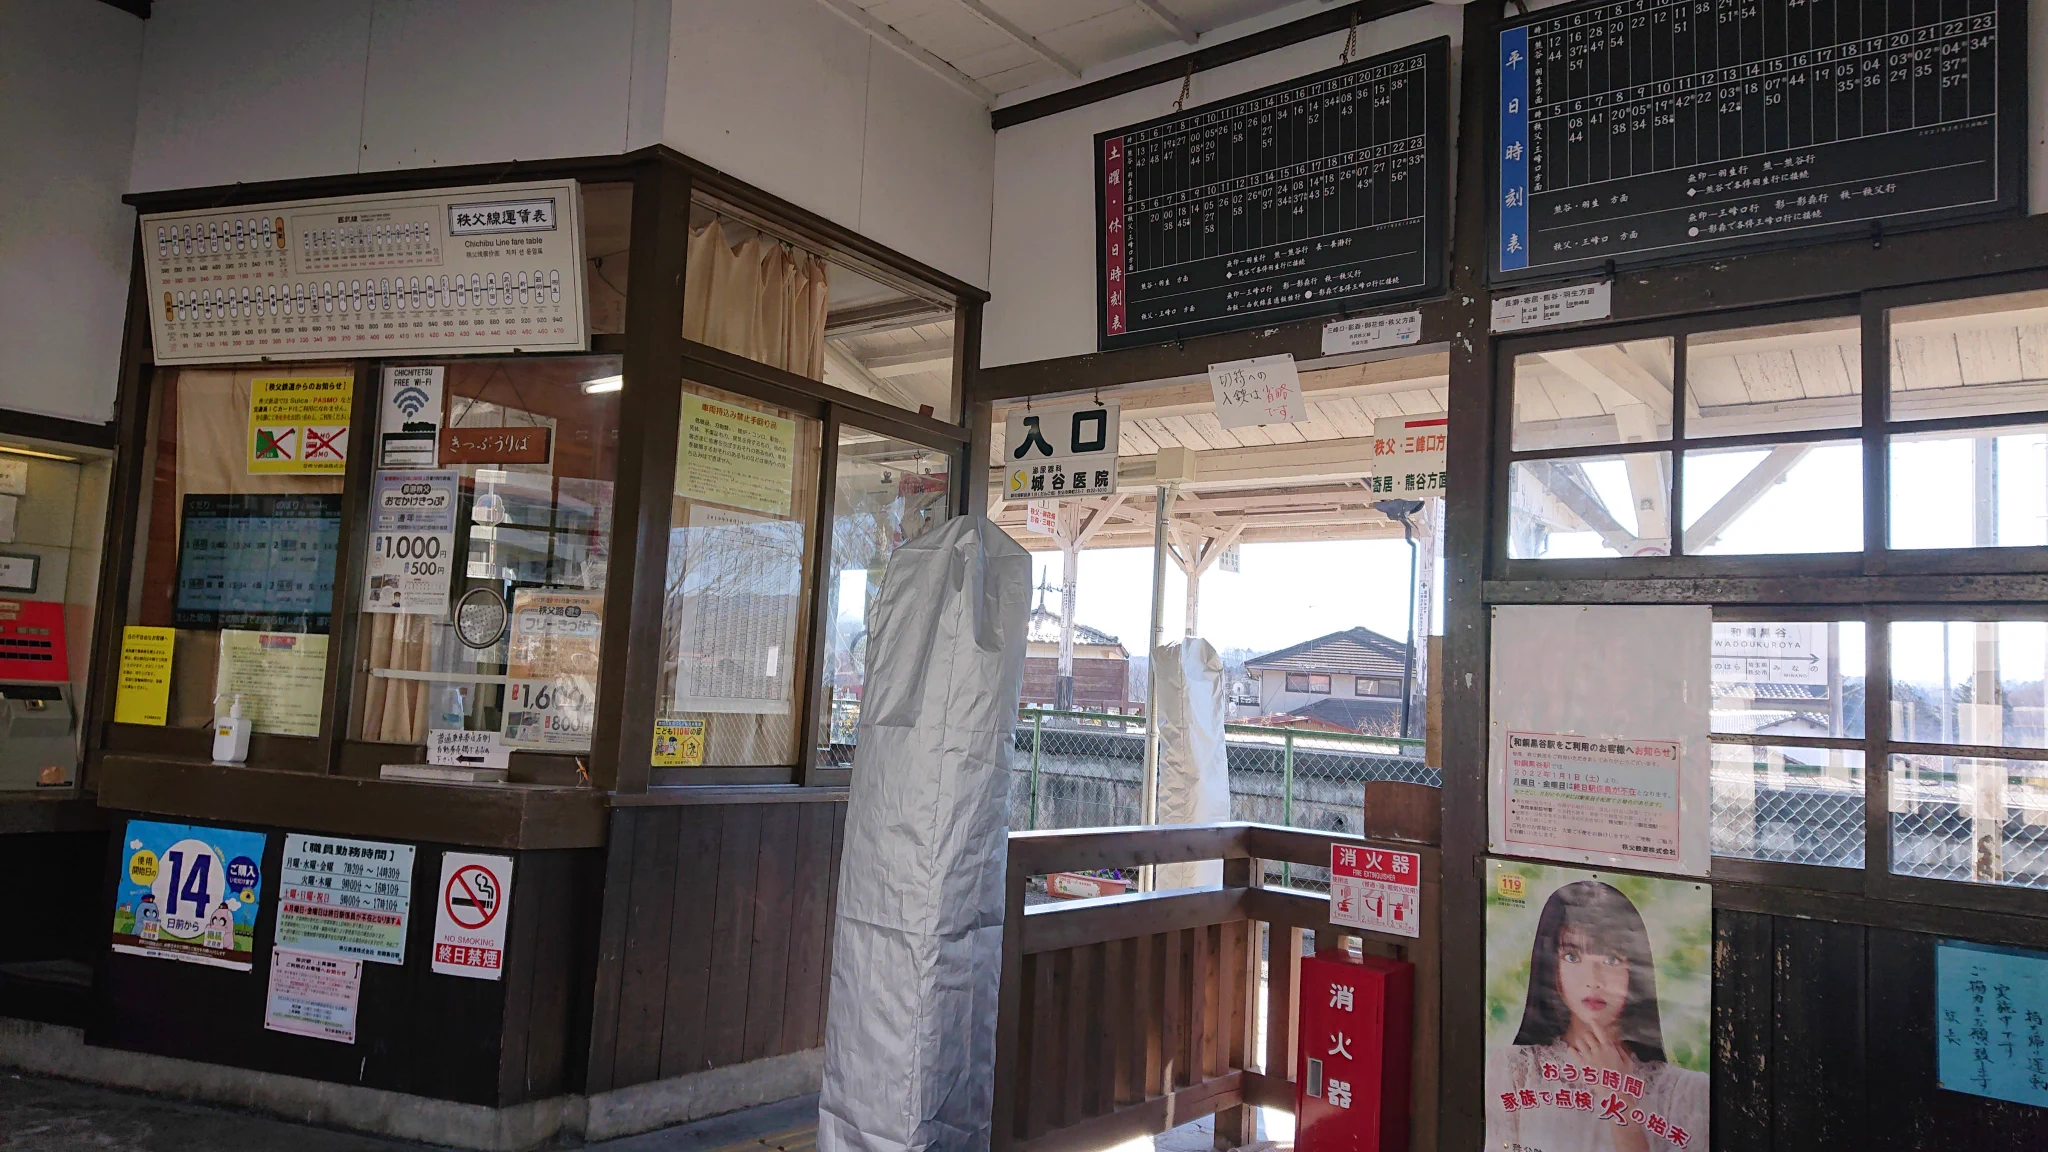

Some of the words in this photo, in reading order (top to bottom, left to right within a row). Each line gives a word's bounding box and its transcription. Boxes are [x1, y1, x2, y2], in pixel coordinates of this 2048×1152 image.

[1569, 31, 1582, 42] 16
[1589, 26, 1603, 38] 28
[1610, 21, 1624, 33] 20
[1632, 16, 1645, 29] 22
[1654, 12, 1667, 24] 12
[1554, 105, 1561, 115] 5
[1575, 101, 1582, 111] 6
[1595, 96, 1603, 106] 7
[1616, 92, 1624, 102] 8
[1637, 87, 1645, 98] 9
[1657, 82, 1671, 94] 10
[1679, 78, 1691, 90] 11
[1701, 74, 1714, 85] 12
[1723, 69, 1737, 80] 13
[1746, 64, 1760, 76] 14
[1769, 60, 1783, 72] 15
[1792, 55, 1807, 67] 16
[1817, 50, 1832, 62] 17
[1842, 44, 1857, 57] 18
[1867, 38, 1883, 52] 19
[1891, 34, 1909, 47] 20
[1918, 27, 1935, 40] 21
[1945, 22, 1963, 36] 22
[1973, 16, 1992, 30] 23
[1863, 58, 1881, 72] 04
[1766, 93, 1781, 106] 50
[1863, 74, 1881, 88] 36
[1890, 68, 1908, 82] 29
[1915, 64, 1932, 78] 35
[1195, 117, 1200, 125] 9
[1207, 113, 1216, 122] 10
[1177, 136, 1186, 145] 27
[1190, 132, 1200, 141] 00
[1218, 126, 1228, 135] 26
[1233, 122, 1242, 131] 10
[1504, 50, 1524, 253] 平日時刻表
[1554, 198, 1599, 214] 熊谷・羽生
[1610, 194, 1629, 205] 方面
[457, 209, 547, 227] 秩父線運賃表
[465, 240, 494, 248] Chichibu
[1108, 146, 1123, 330] 土曜・休日時刻表
[1554, 235, 1609, 251] 秩父・三峰口
[1620, 231, 1638, 241] 方面
[394, 379, 410, 387] FREE
[1218, 370, 1267, 388] 切符への
[1014, 409, 1107, 459] 入口
[450, 435, 532, 453] きっぷうりば
[1031, 470, 1109, 491] 城谷医院
[385, 496, 445, 506] おでかけきっぷ
[1715, 640, 1801, 649] WADOUKUROYA
[137, 856, 153, 866] 使用
[287, 857, 334, 872] 月曜・水曜・金曜
[1340, 847, 1410, 875] 消火器
[131, 866, 156, 877] 開始日の
[230, 864, 257, 878] ご購入
[1352, 869, 1363, 877] FIRE
[1364, 870, 1396, 881] EXTINGUISHER
[165, 850, 212, 919] 14
[302, 875, 332, 887] 火曜・木曜
[1502, 878, 1521, 890] 119
[284, 889, 330, 903] 土曜・日曜・祝日
[166, 918, 200, 932] 日前から
[457, 937, 494, 947] SMOKING
[438, 944, 498, 968] 終日禁煙
[1328, 983, 1354, 1109] 消火器
[1542, 1063, 1645, 1098] おうち時間
[1500, 1088, 1594, 1112] 家族で点検
[1600, 1092, 1692, 1150] 火の始末
